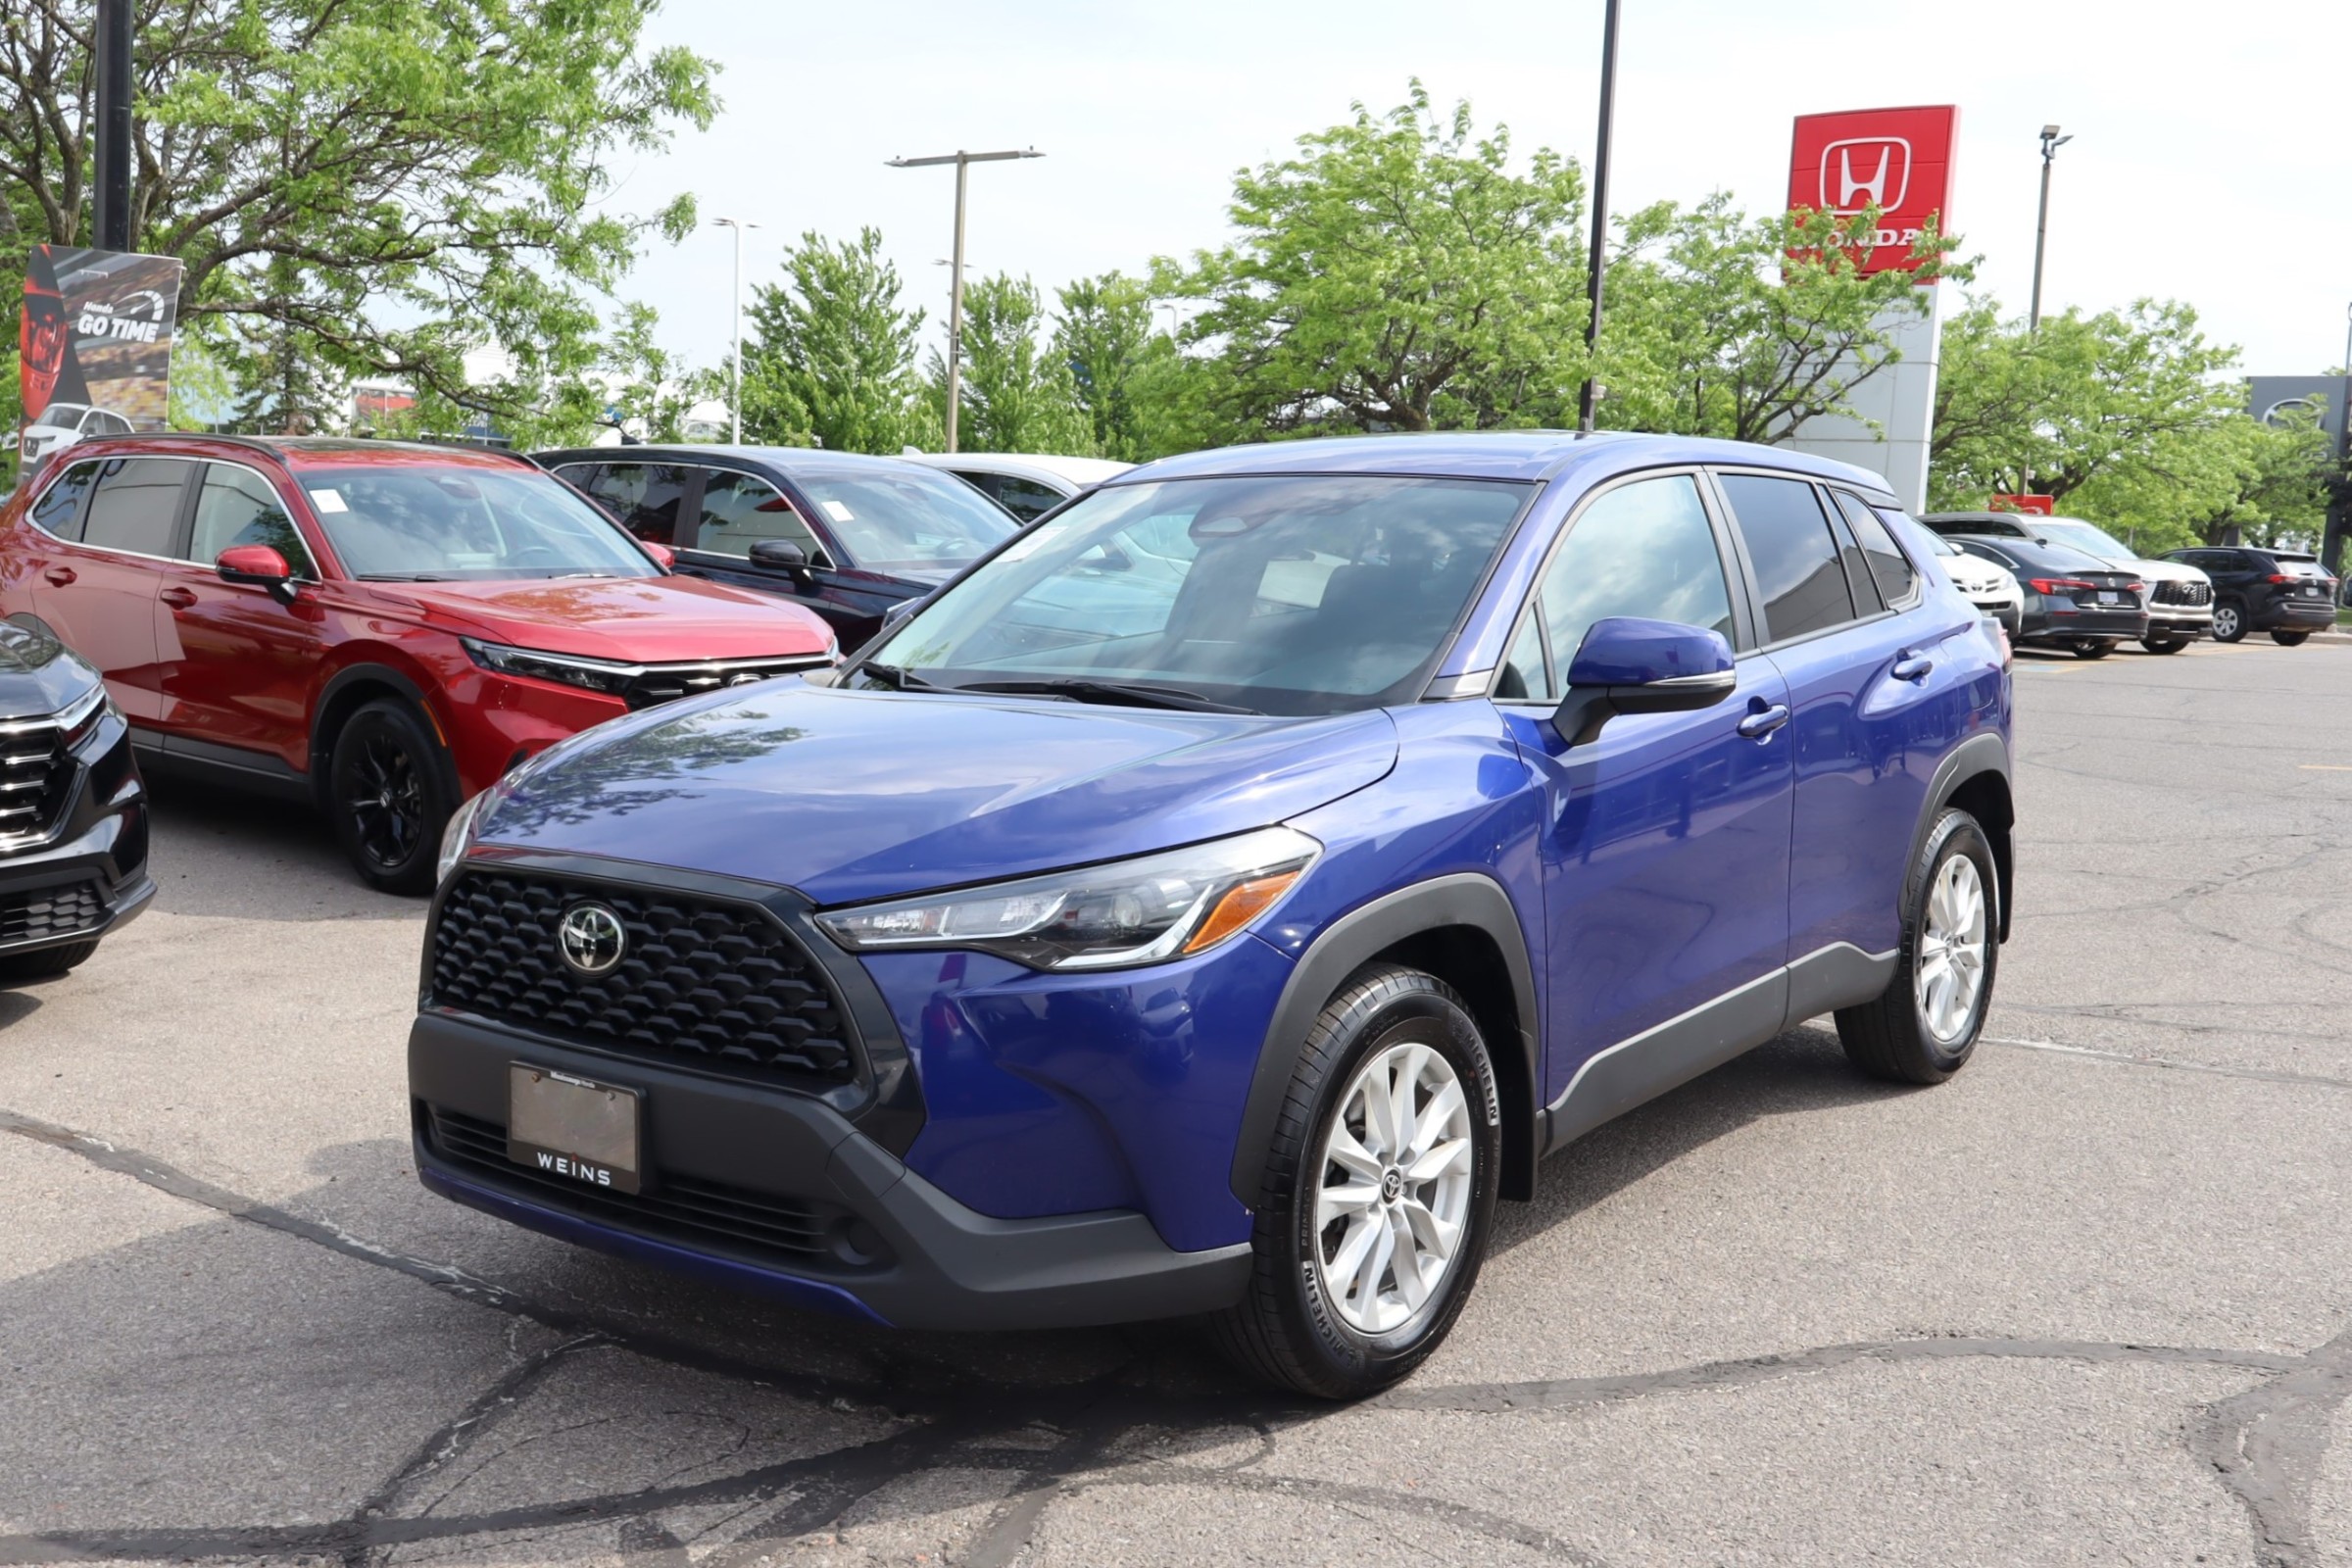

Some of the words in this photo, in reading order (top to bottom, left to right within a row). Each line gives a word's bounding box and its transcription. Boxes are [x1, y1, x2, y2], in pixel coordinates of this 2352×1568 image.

[1792, 227, 1923, 251] ONDA
[83, 301, 114, 314] Honda
[77, 314, 109, 336] GO
[110, 318, 160, 343] TIME
[1463, 1035, 1498, 1119] MICHELIN
[537, 1152, 611, 1186] WEINS
[1303, 1267, 1348, 1357] MICHELIN
